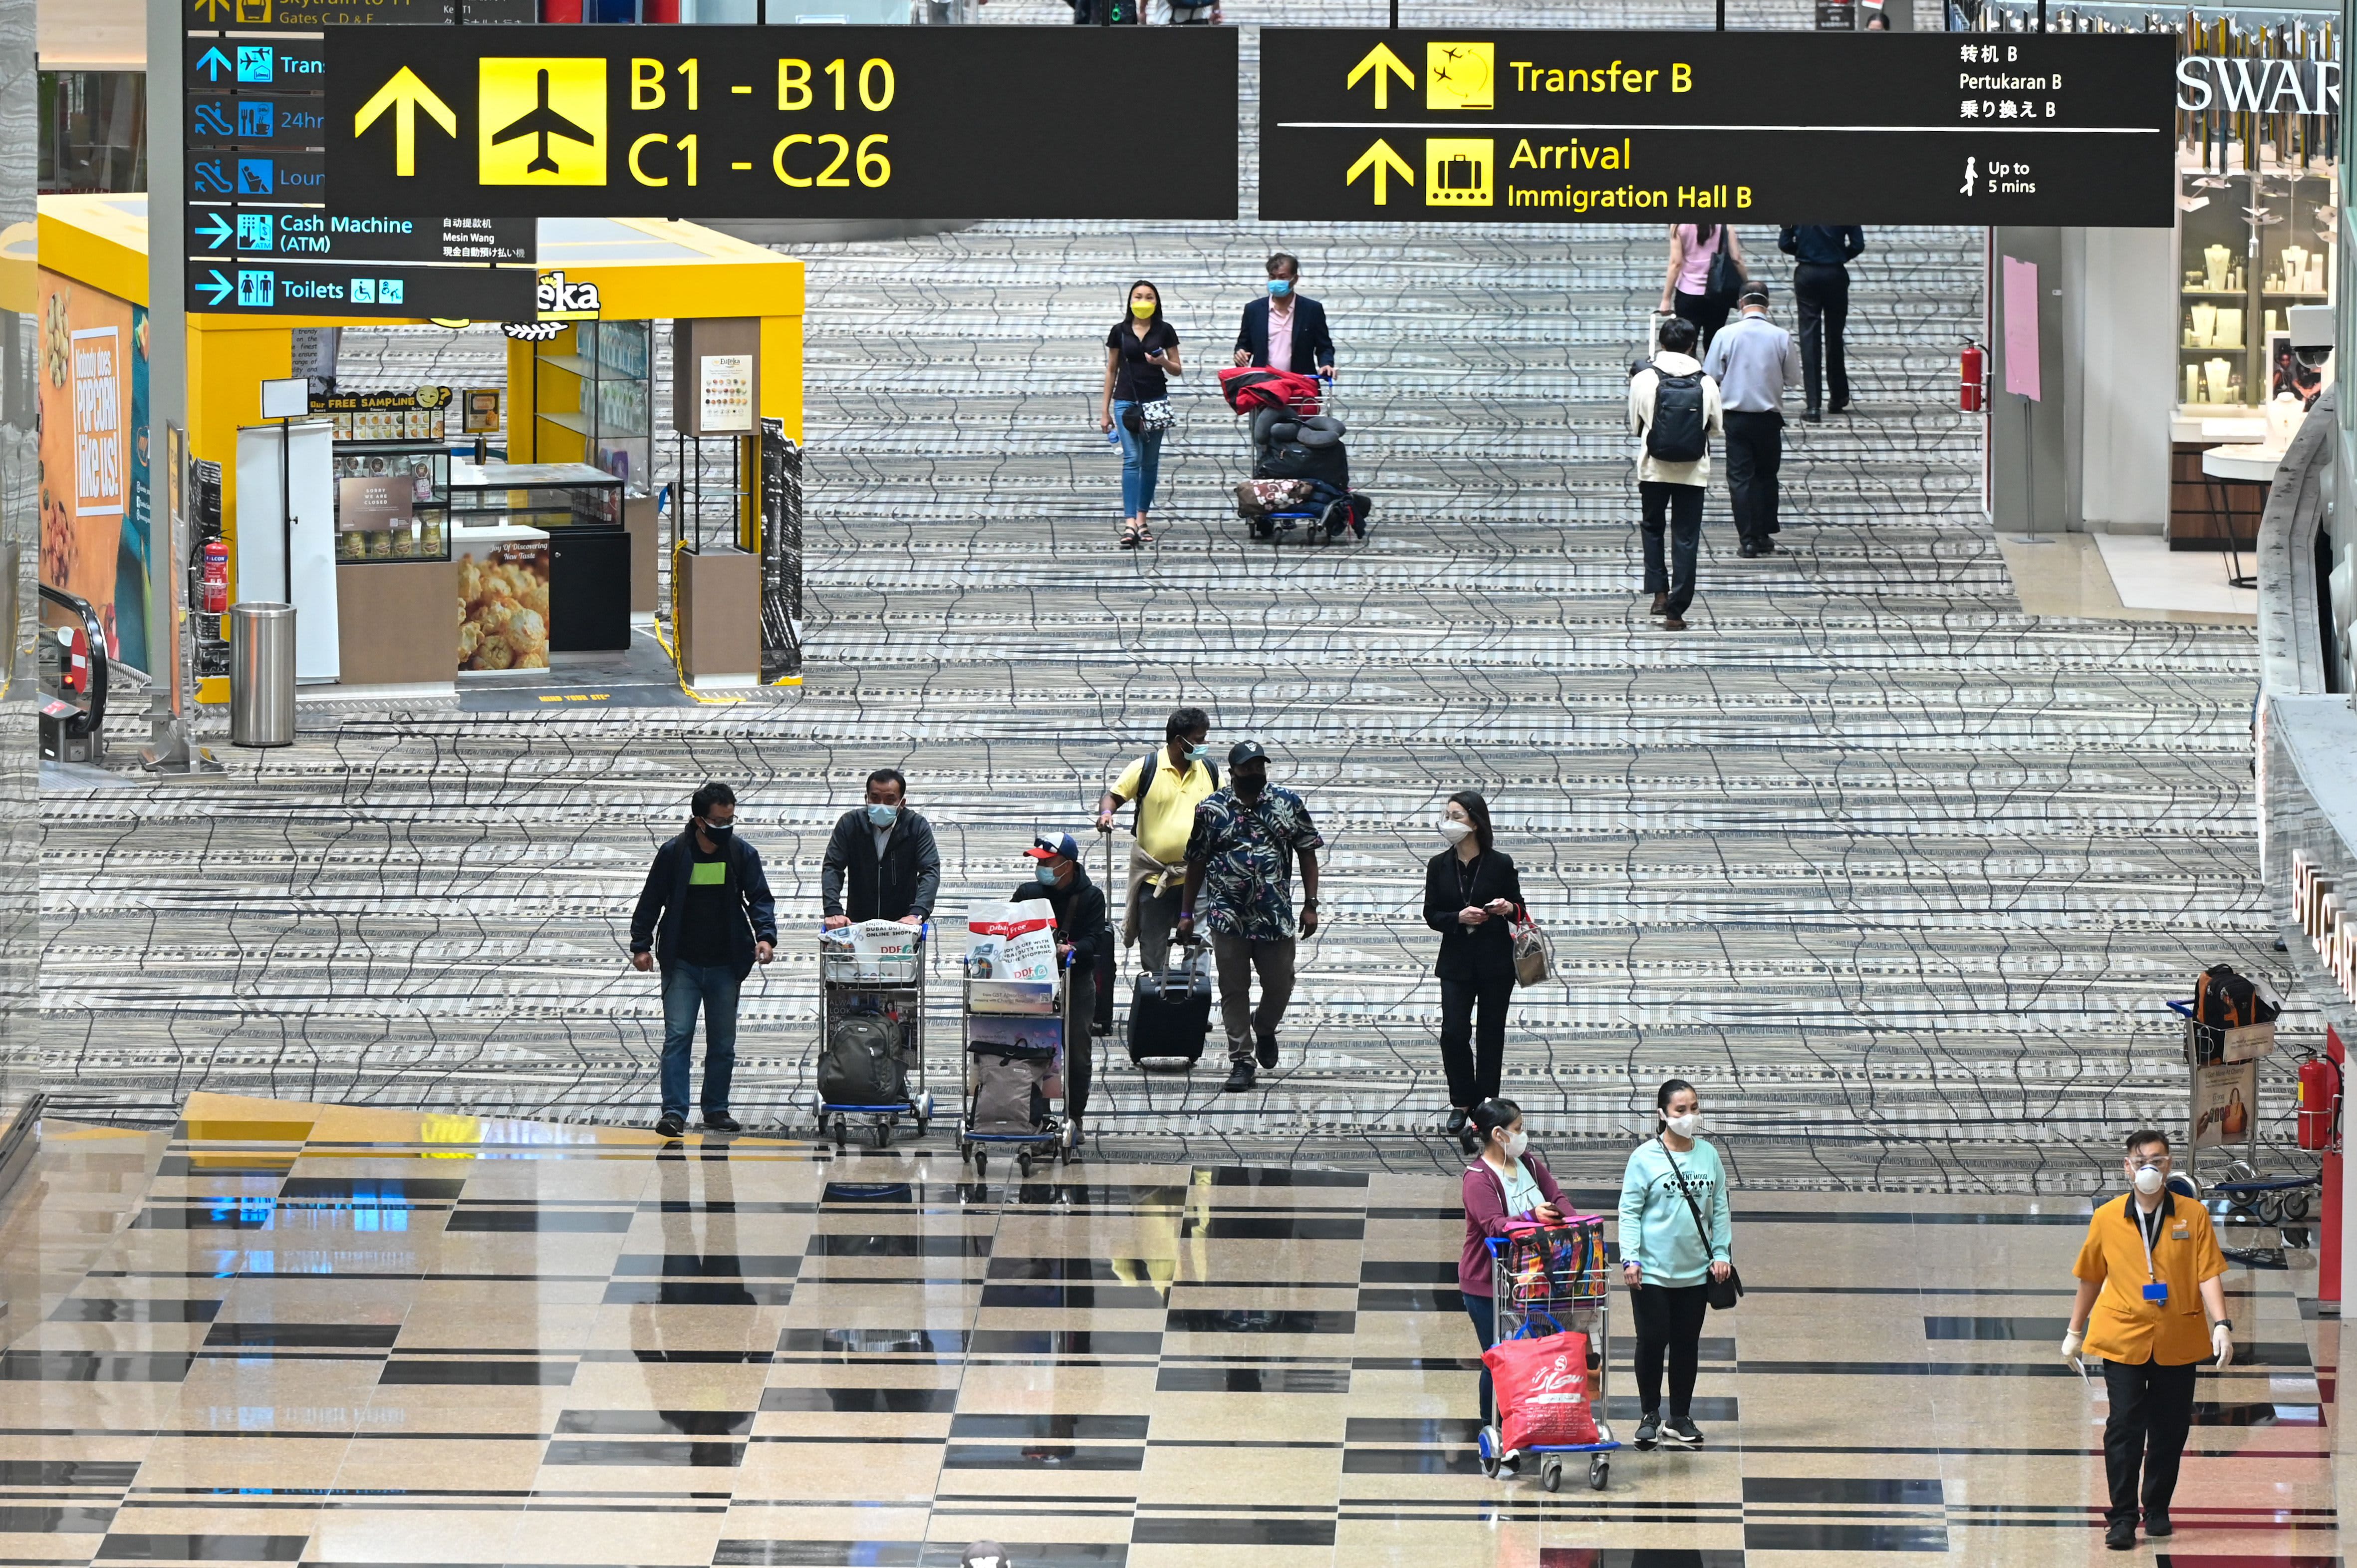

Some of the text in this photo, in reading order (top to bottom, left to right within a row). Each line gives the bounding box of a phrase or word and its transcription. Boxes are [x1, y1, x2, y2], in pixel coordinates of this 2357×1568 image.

[279, 12, 317, 23] Gates
[339, 13, 349, 23] D
[354, 15, 361, 23] &
[444, 5, 454, 13] Ke
[1960, 44, 2018, 63] 转机 B
[280, 56, 324, 73] Tran
[631, 57, 698, 110] B1
[778, 58, 895, 112] B10
[1509, 60, 1692, 93] Transfer B
[1960, 72, 2062, 90] Pertukaran B
[2176, 56, 2341, 115] SWAR
[1960, 99, 2056, 119] 乗り換え B
[281, 111, 324, 128] 24hr
[628, 133, 697, 187] C1
[773, 133, 891, 188] C26
[1509, 138, 1630, 170] Arrival
[280, 169, 324, 186] Loun
[1989, 161, 2030, 178] Up to
[1989, 179, 2036, 193] 5 mins
[1508, 184, 1752, 213] Immigration Hall B
[280, 214, 413, 234] Cash Machine
[443, 217, 492, 229] 自动提款机
[280, 235, 331, 254] (ATM)
[443, 232, 495, 245] Mesin Wang
[443, 246, 525, 258] 現金自動預け払い機
[281, 280, 344, 299] Toilets
[76, 346, 111, 379] Nobody does
[77, 376, 117, 433] POPCORN
[328, 399, 357, 408] FREE
[361, 397, 415, 407] SAMPLING
[78, 434, 99, 499] like
[100, 431, 119, 498] us!
[489, 542, 548, 553] Joy Of Discovering
[880, 945, 902, 954] DDF
[1022, 949, 1052, 959] SHOPPING
[1014, 967, 1034, 979] DDF
